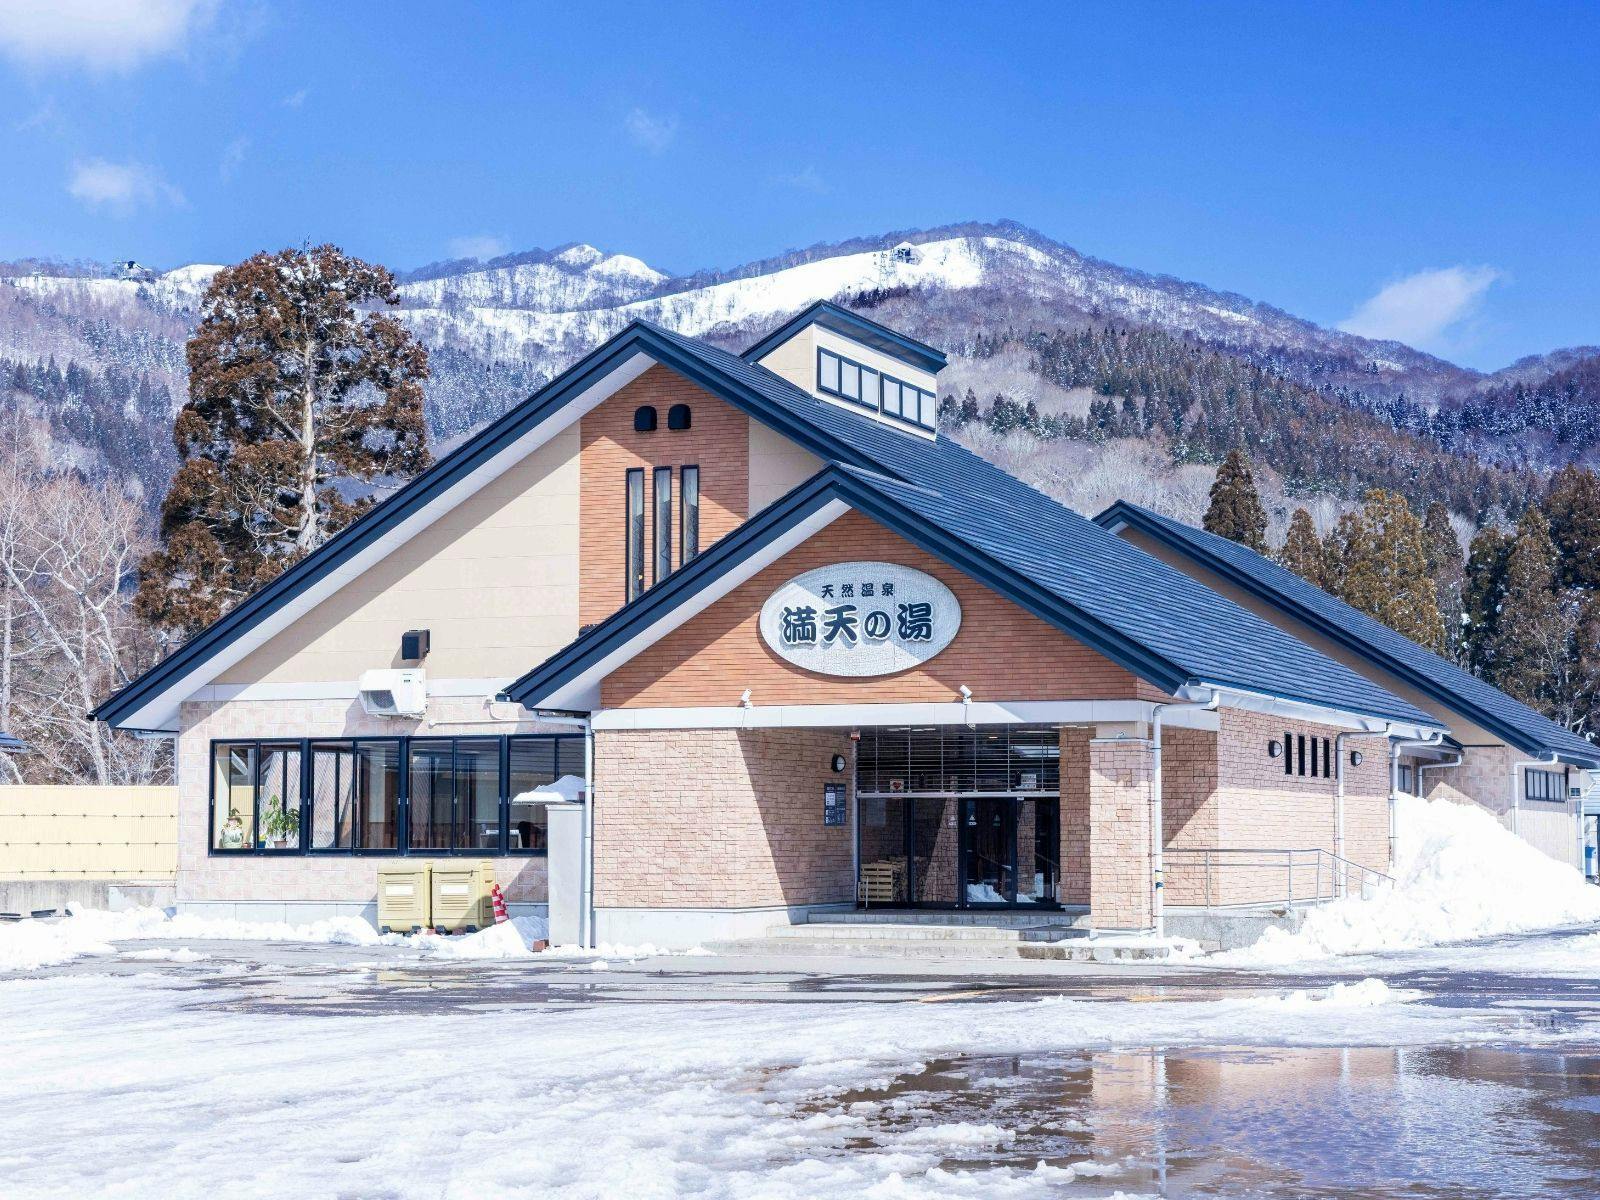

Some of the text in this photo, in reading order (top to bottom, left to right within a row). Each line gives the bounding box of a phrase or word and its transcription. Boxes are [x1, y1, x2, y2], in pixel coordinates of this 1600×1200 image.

[821, 582, 895, 598] 天然温泉
[782, 602, 932, 643] 満天の湯
